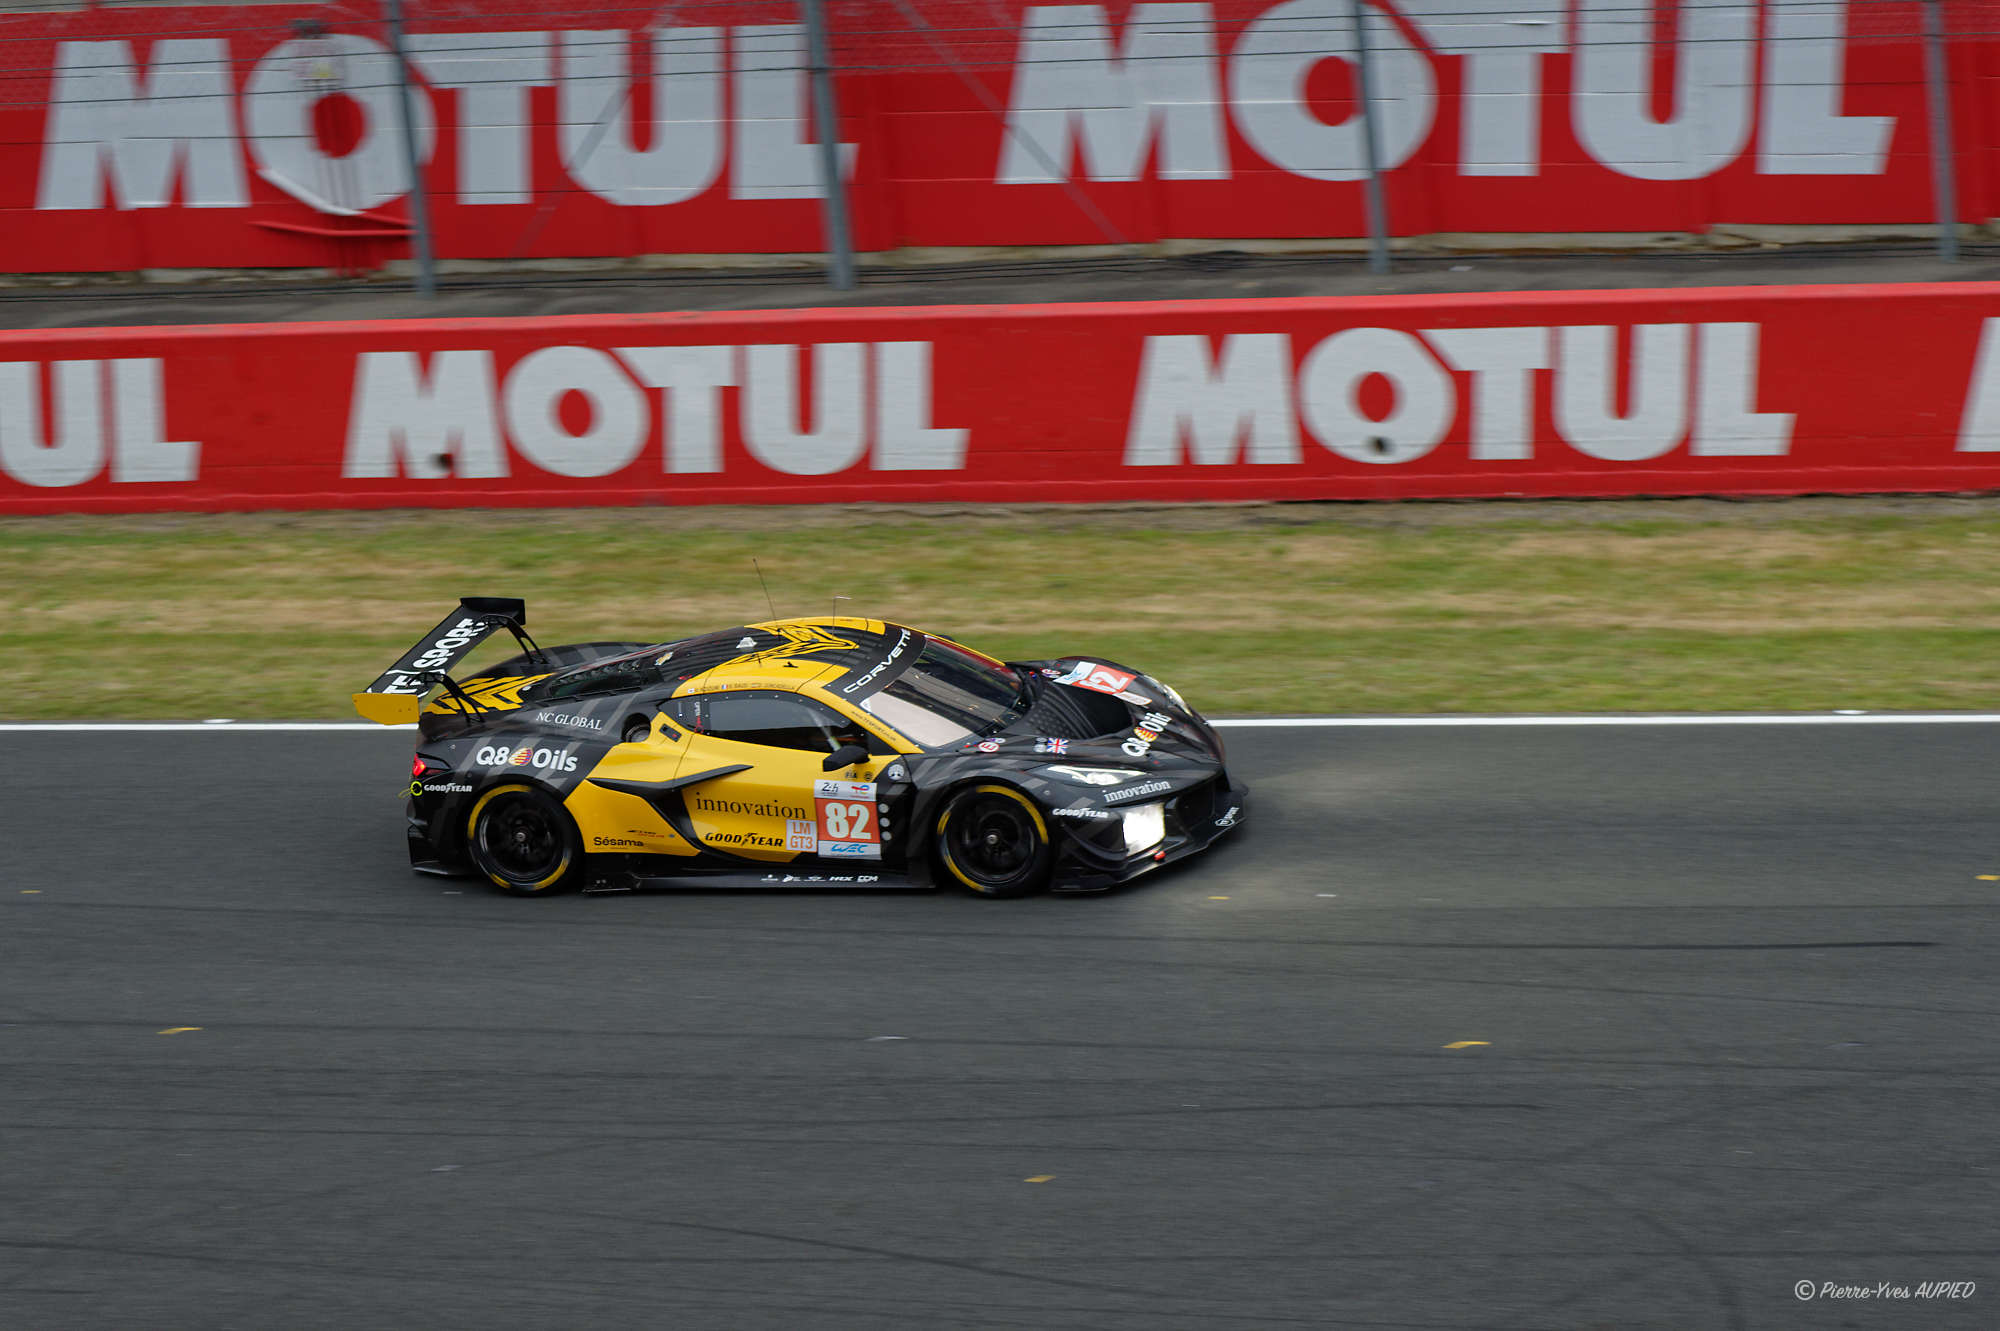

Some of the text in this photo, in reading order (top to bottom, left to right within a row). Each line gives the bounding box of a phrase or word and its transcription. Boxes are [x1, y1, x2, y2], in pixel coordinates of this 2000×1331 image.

[993, 0, 1897, 182] MOTUL
[35, 24, 860, 215] MOTUL
[1123, 322, 1797, 466] MOTUL
[342, 341, 970, 479] MOTUL
[843, 628, 911, 693] CORVETTE
[535, 711, 602, 730] NC GLOBAL
[476, 746, 578, 772] Q8 Oils
[423, 782, 473, 793] GOODYEAR
[1102, 780, 1171, 803] innovation
[695, 791, 807, 819] innovation
[1053, 807, 1110, 819] GOODYEAR
[793, 822, 811, 834] LM
[825, 802, 872, 840] 82
[705, 832, 784, 847] GOODYEAR
[790, 836, 813, 849] GT3
